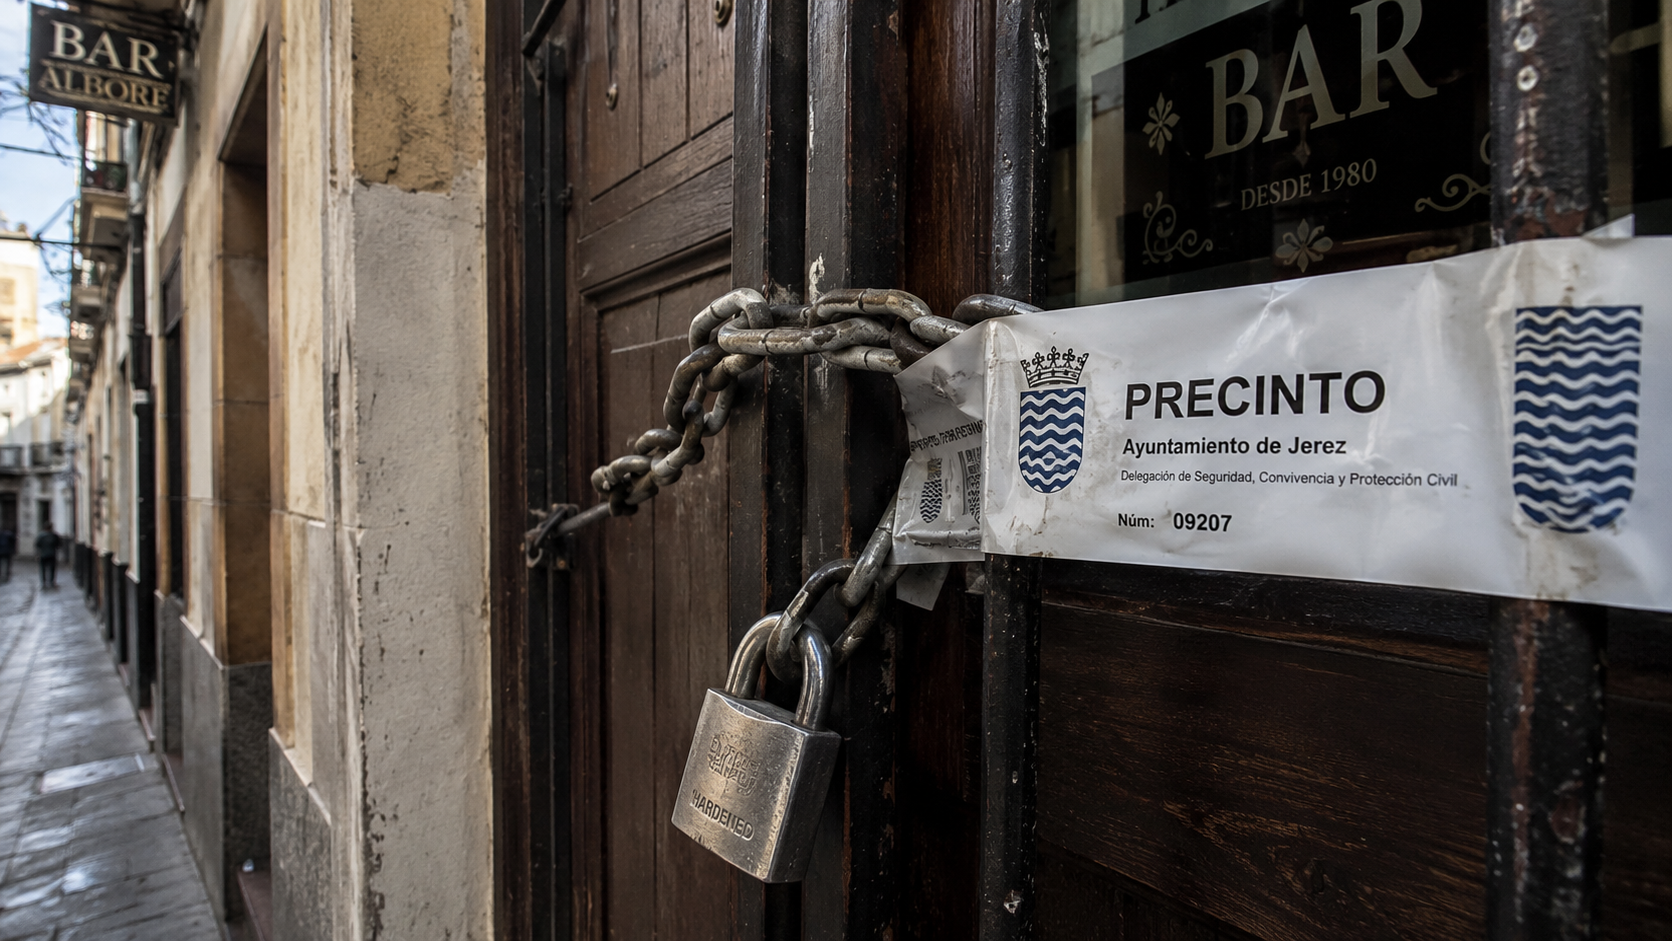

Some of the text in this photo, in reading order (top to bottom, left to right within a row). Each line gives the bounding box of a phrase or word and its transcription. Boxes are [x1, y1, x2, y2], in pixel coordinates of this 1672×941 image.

[49, 19, 163, 79] BAR
[1204, 0, 1437, 159] BAR
[1240, 158, 1378, 212] DESDE 1980
[1125, 370, 1386, 421] PRECINTO
[1122, 436, 1347, 459] Ayuntamiento de Jerez
[1120, 469, 1458, 487] Delegación de Seguridad, Convivencia y Protección Civil
[1117, 512, 1233, 533] Núm: 09207
